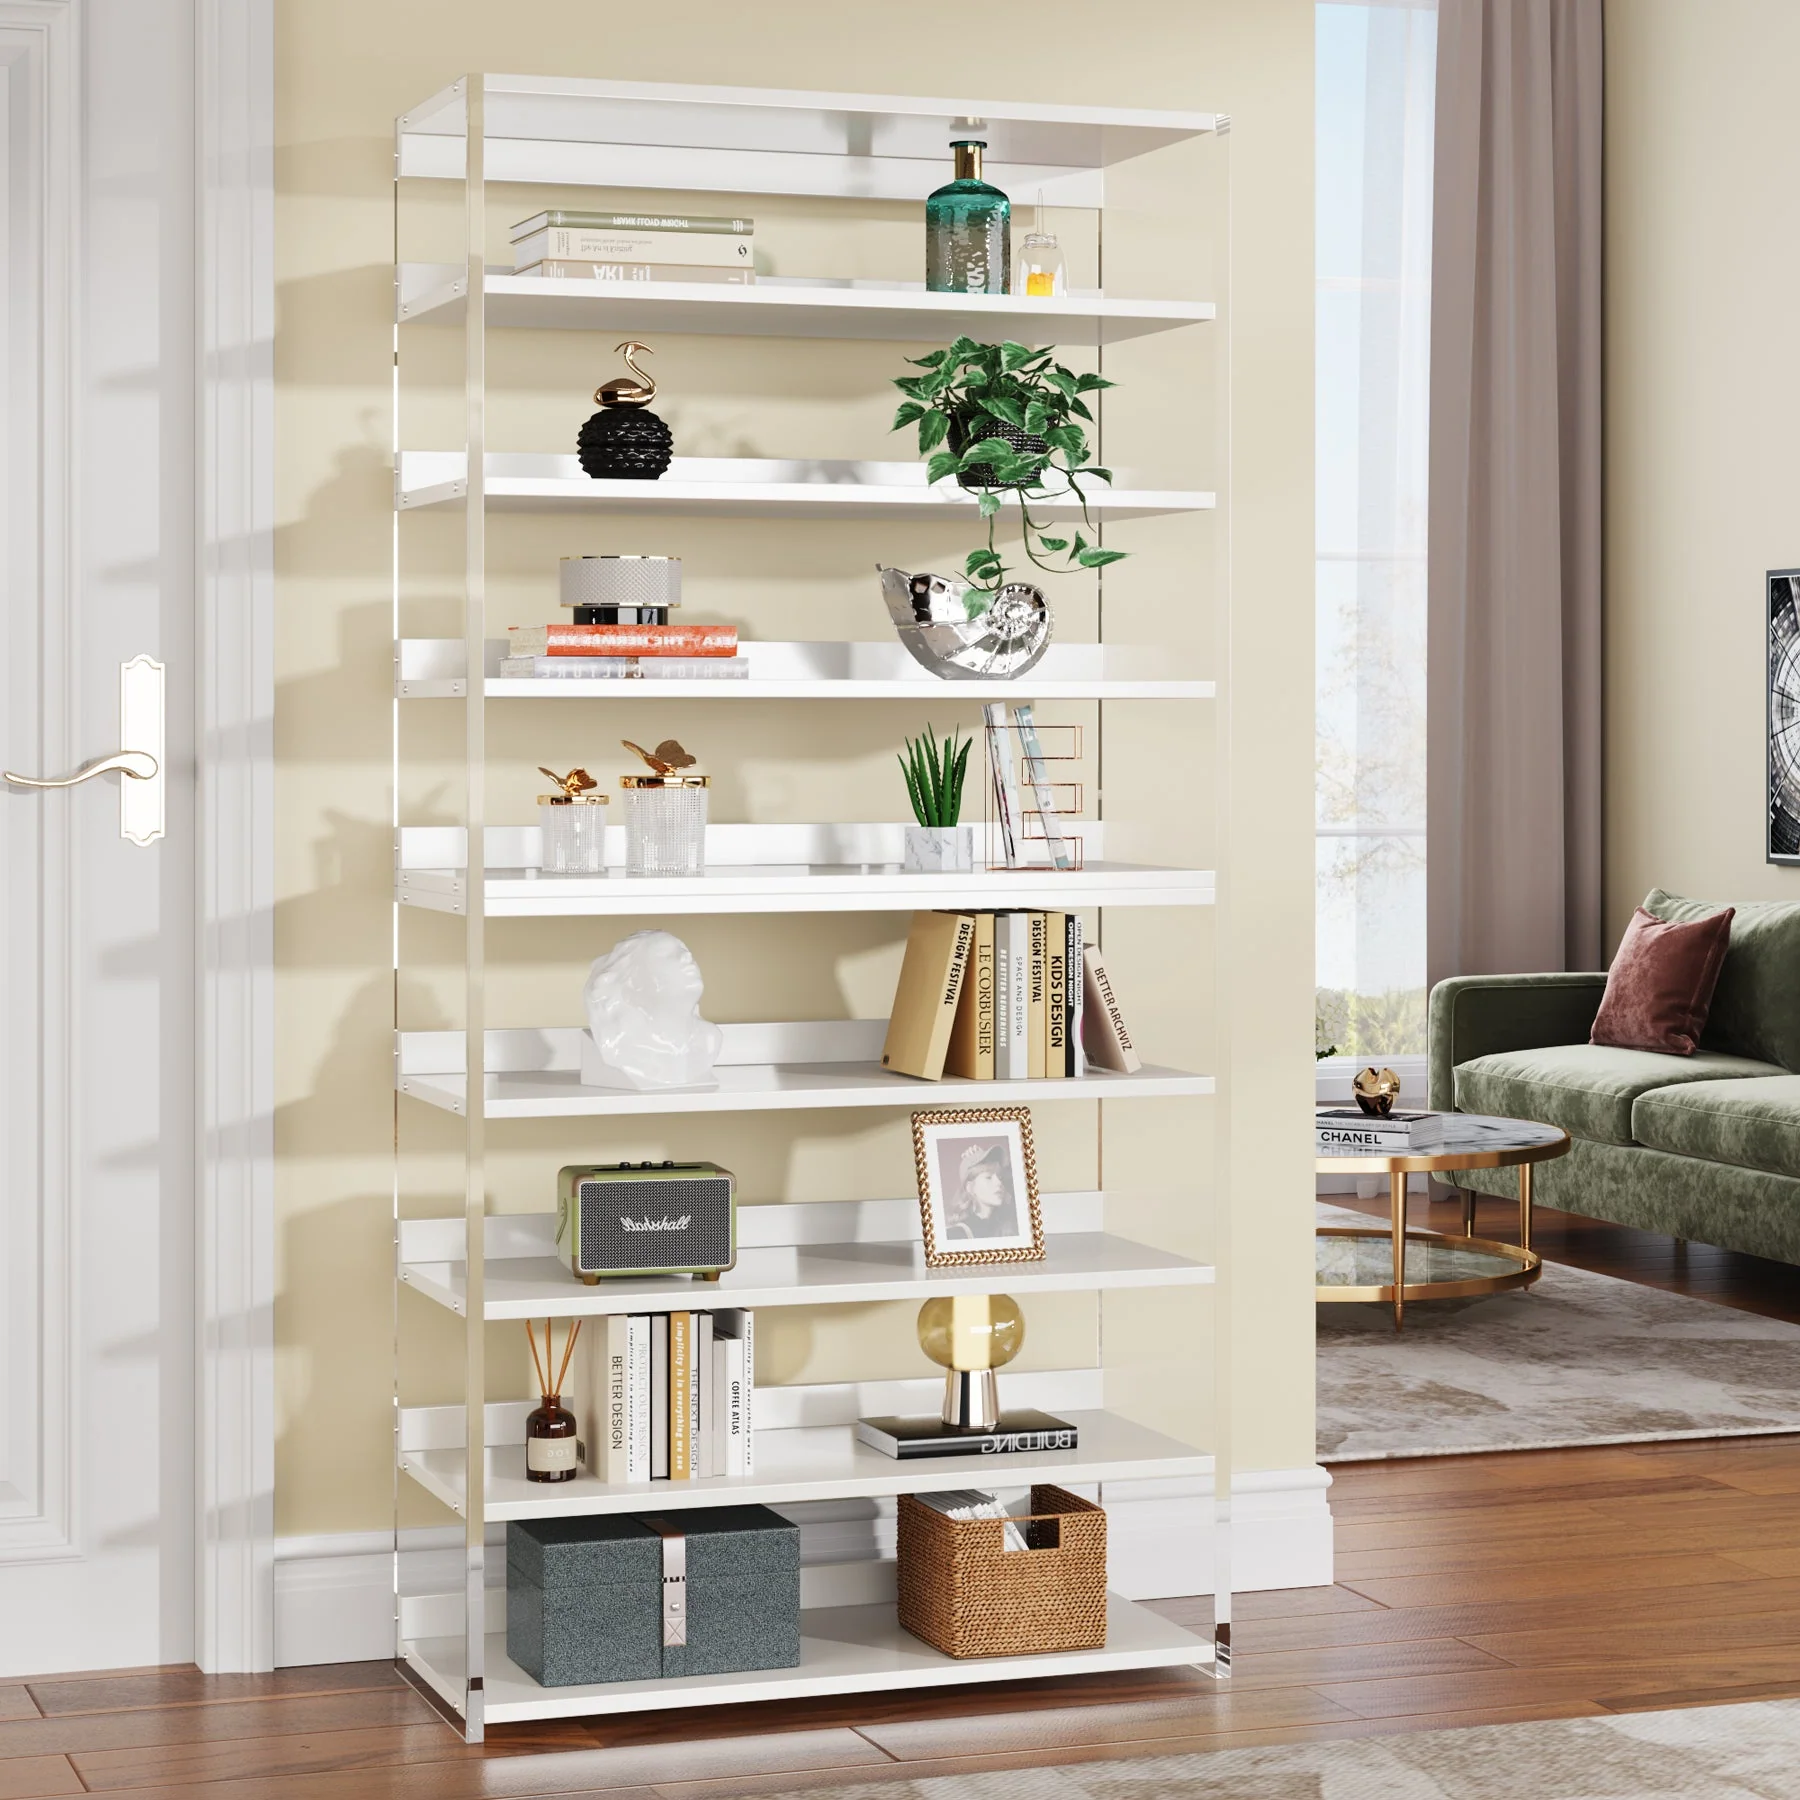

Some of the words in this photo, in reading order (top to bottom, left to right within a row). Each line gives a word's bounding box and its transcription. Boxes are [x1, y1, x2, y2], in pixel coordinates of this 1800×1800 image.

[954, 923, 971, 960] DESIGN
[978, 944, 992, 963] LE
[1032, 920, 1042, 956] DESIGN
[944, 962, 962, 1005] FESTIVAL
[1015, 956, 1023, 982] SPACE
[1032, 960, 1042, 1003] FESTIVAL
[1051, 955, 1063, 990] KIDS
[978, 966, 992, 1056] CORBUSIER
[1015, 985, 1023, 1003] AND
[1094, 967, 1116, 1006] BETTER
[1108, 1007, 1133, 1052] ARCHVIZ
[1015, 1006, 1023, 1036] DESIGN
[1051, 993, 1063, 1048] DESIGN
[1320, 1131, 1382, 1145] CHANEL
[611, 1355, 623, 1399] BETTER
[731, 1381, 740, 1409] COFFEE
[611, 1402, 623, 1450] DESIGN
[731, 1411, 740, 1435] ATLAS
